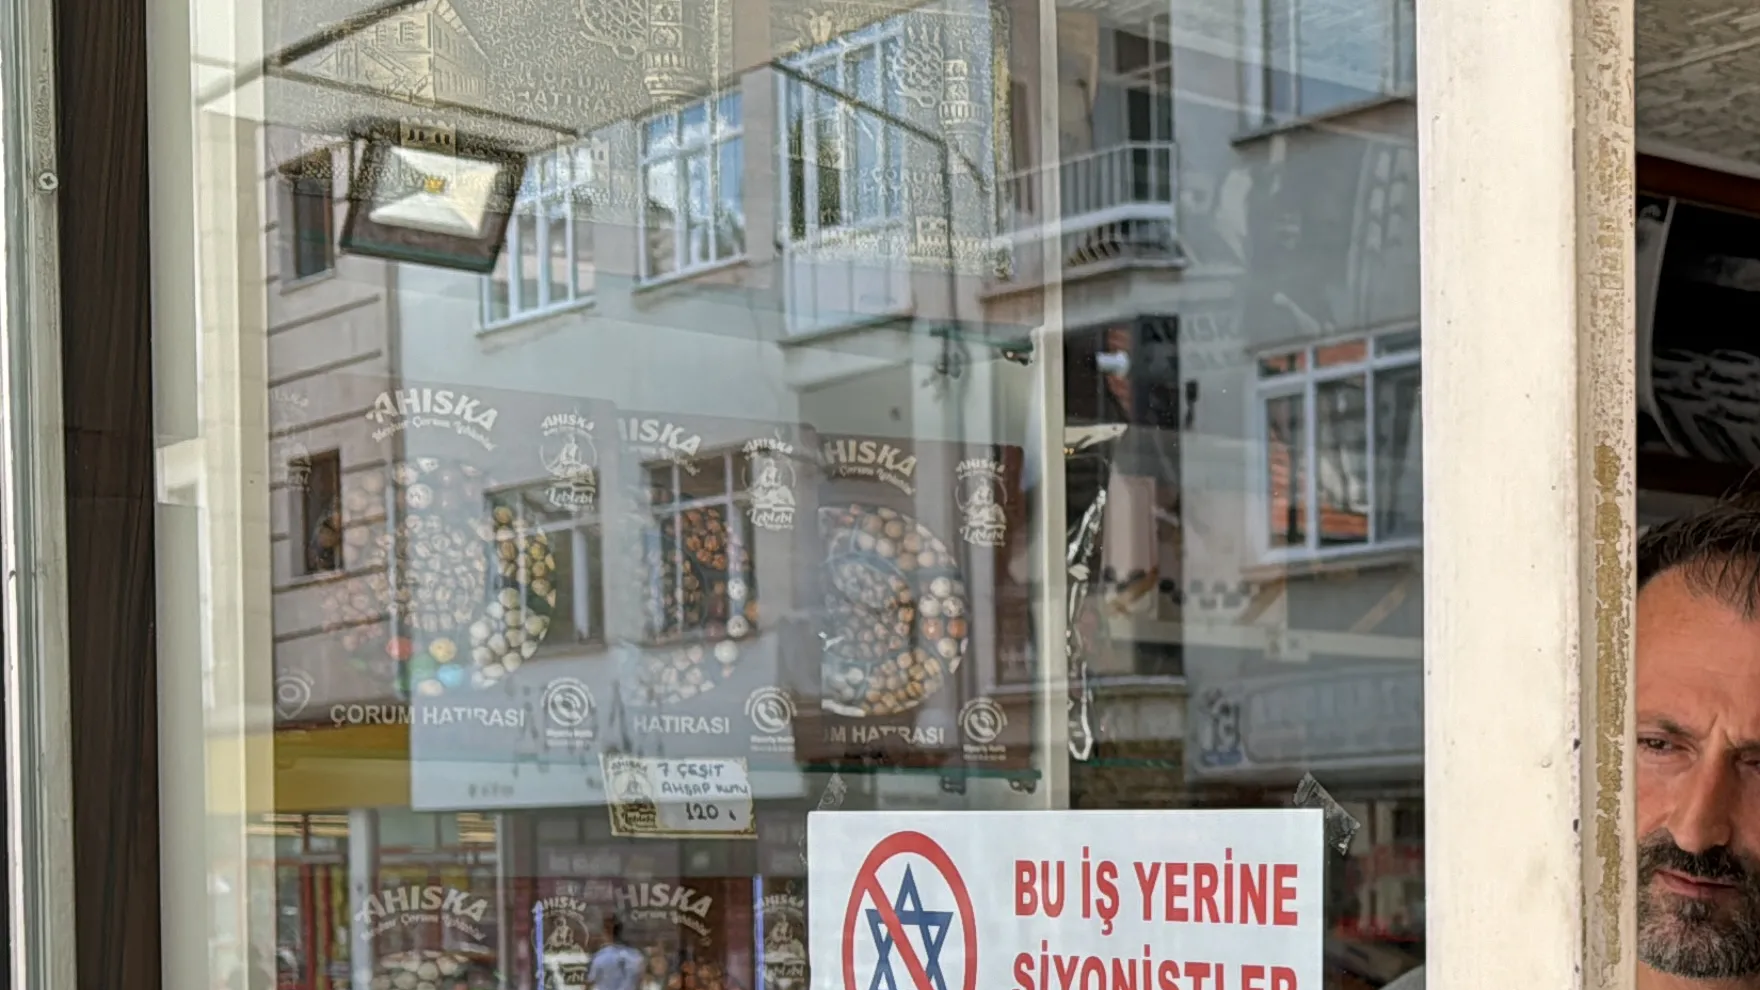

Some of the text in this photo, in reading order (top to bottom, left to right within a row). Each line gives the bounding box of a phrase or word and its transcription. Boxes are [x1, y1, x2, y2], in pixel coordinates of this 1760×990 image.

[365, 388, 498, 431] AHISKA
[330, 704, 525, 727] ÇORUM HATIRASI
[633, 714, 731, 735] HATIRASI
[686, 801, 720, 821] 120
[354, 885, 488, 923] AHISKA
[1015, 846, 1299, 934] BU İŞ YERİNE
